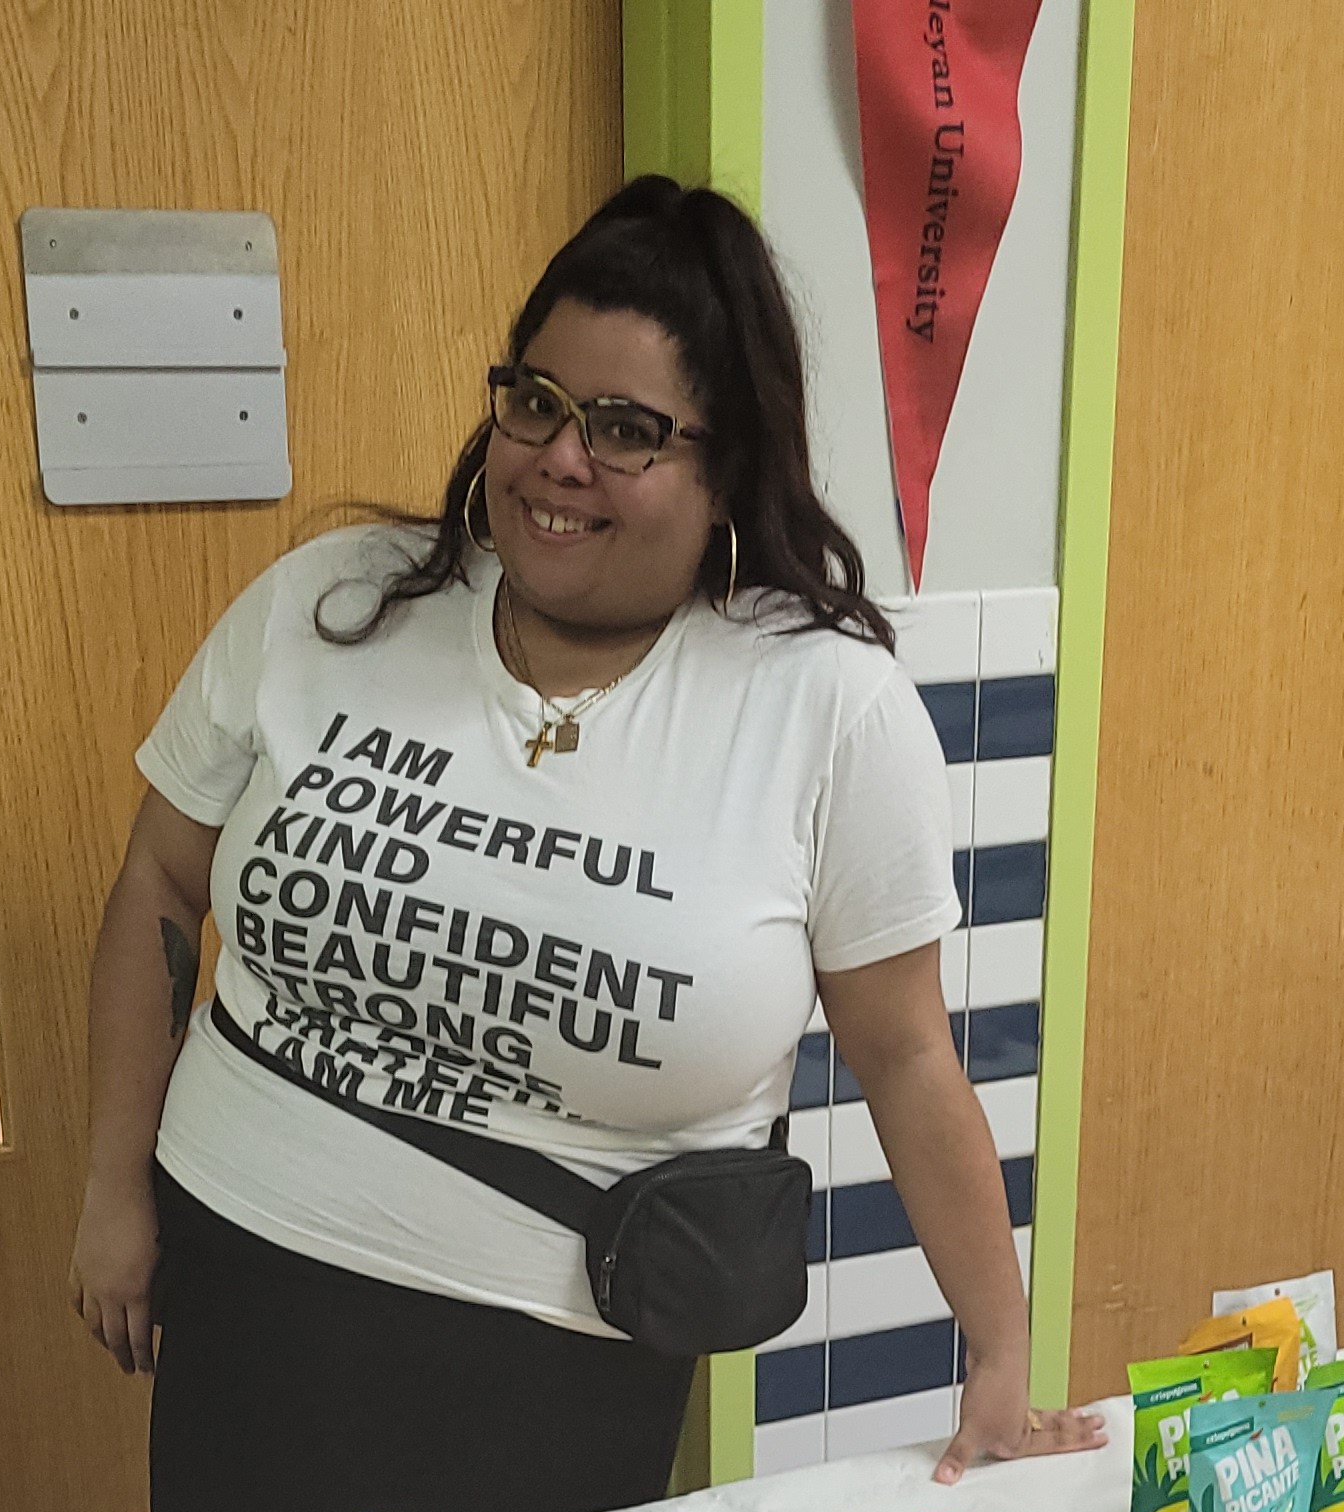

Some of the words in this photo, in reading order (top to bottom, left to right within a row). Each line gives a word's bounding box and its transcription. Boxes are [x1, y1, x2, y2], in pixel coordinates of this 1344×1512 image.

[906, 121, 965, 344] University
[317, 712, 348, 754] I
[348, 727, 454, 787] AM
[254, 807, 430, 884] KIND
[284, 763, 674, 901] POWERFUL
[235, 905, 663, 1069] BEAUTIFUL
[238, 857, 694, 1022] CONFIDENT
[242, 955, 534, 1069] STRONG
[274, 1037, 364, 1098] AM
[383, 1078, 489, 1129] ME
